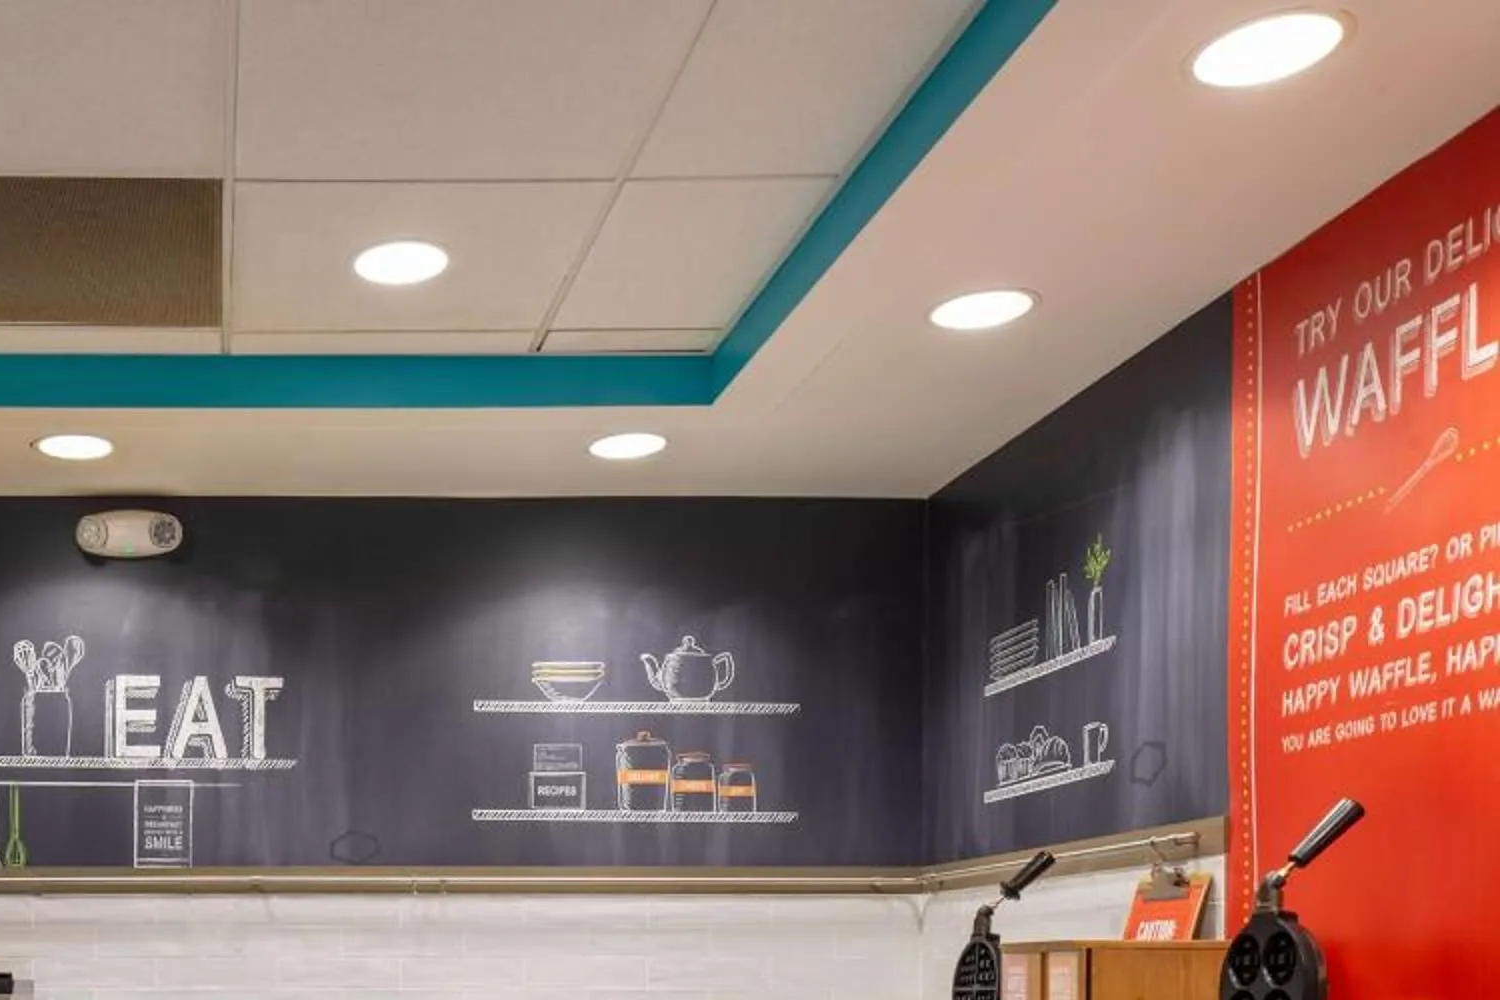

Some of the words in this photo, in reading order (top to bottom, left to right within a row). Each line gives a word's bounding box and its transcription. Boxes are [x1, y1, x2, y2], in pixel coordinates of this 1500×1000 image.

[1294, 298, 1341, 356] TRY
[1353, 257, 1412, 320] OUR
[1293, 281, 1499, 459] WAFFL
[1284, 590, 1311, 617] FILL
[1317, 574, 1357, 606] EACH
[1363, 544, 1439, 592] SQUARE?
[1446, 533, 1472, 560] OR
[1284, 615, 1357, 671] CRISP
[1368, 605, 1385, 646] &
[1282, 676, 1341, 718] HAPPY
[1349, 651, 1438, 699] WAFFLE,
[106, 673, 285, 768] EAT
[1282, 733, 1304, 753] YOU
[1307, 726, 1331, 748] ARE
[1335, 715, 1375, 742] GOING
[1380, 710, 1397, 730] TO
[1401, 701, 1438, 728] LOVE
[1441, 697, 1456, 718] IT
[1460, 695, 1471, 715] A
[537, 784, 577, 797] RECIPES
[144, 835, 183, 851] SMILE
